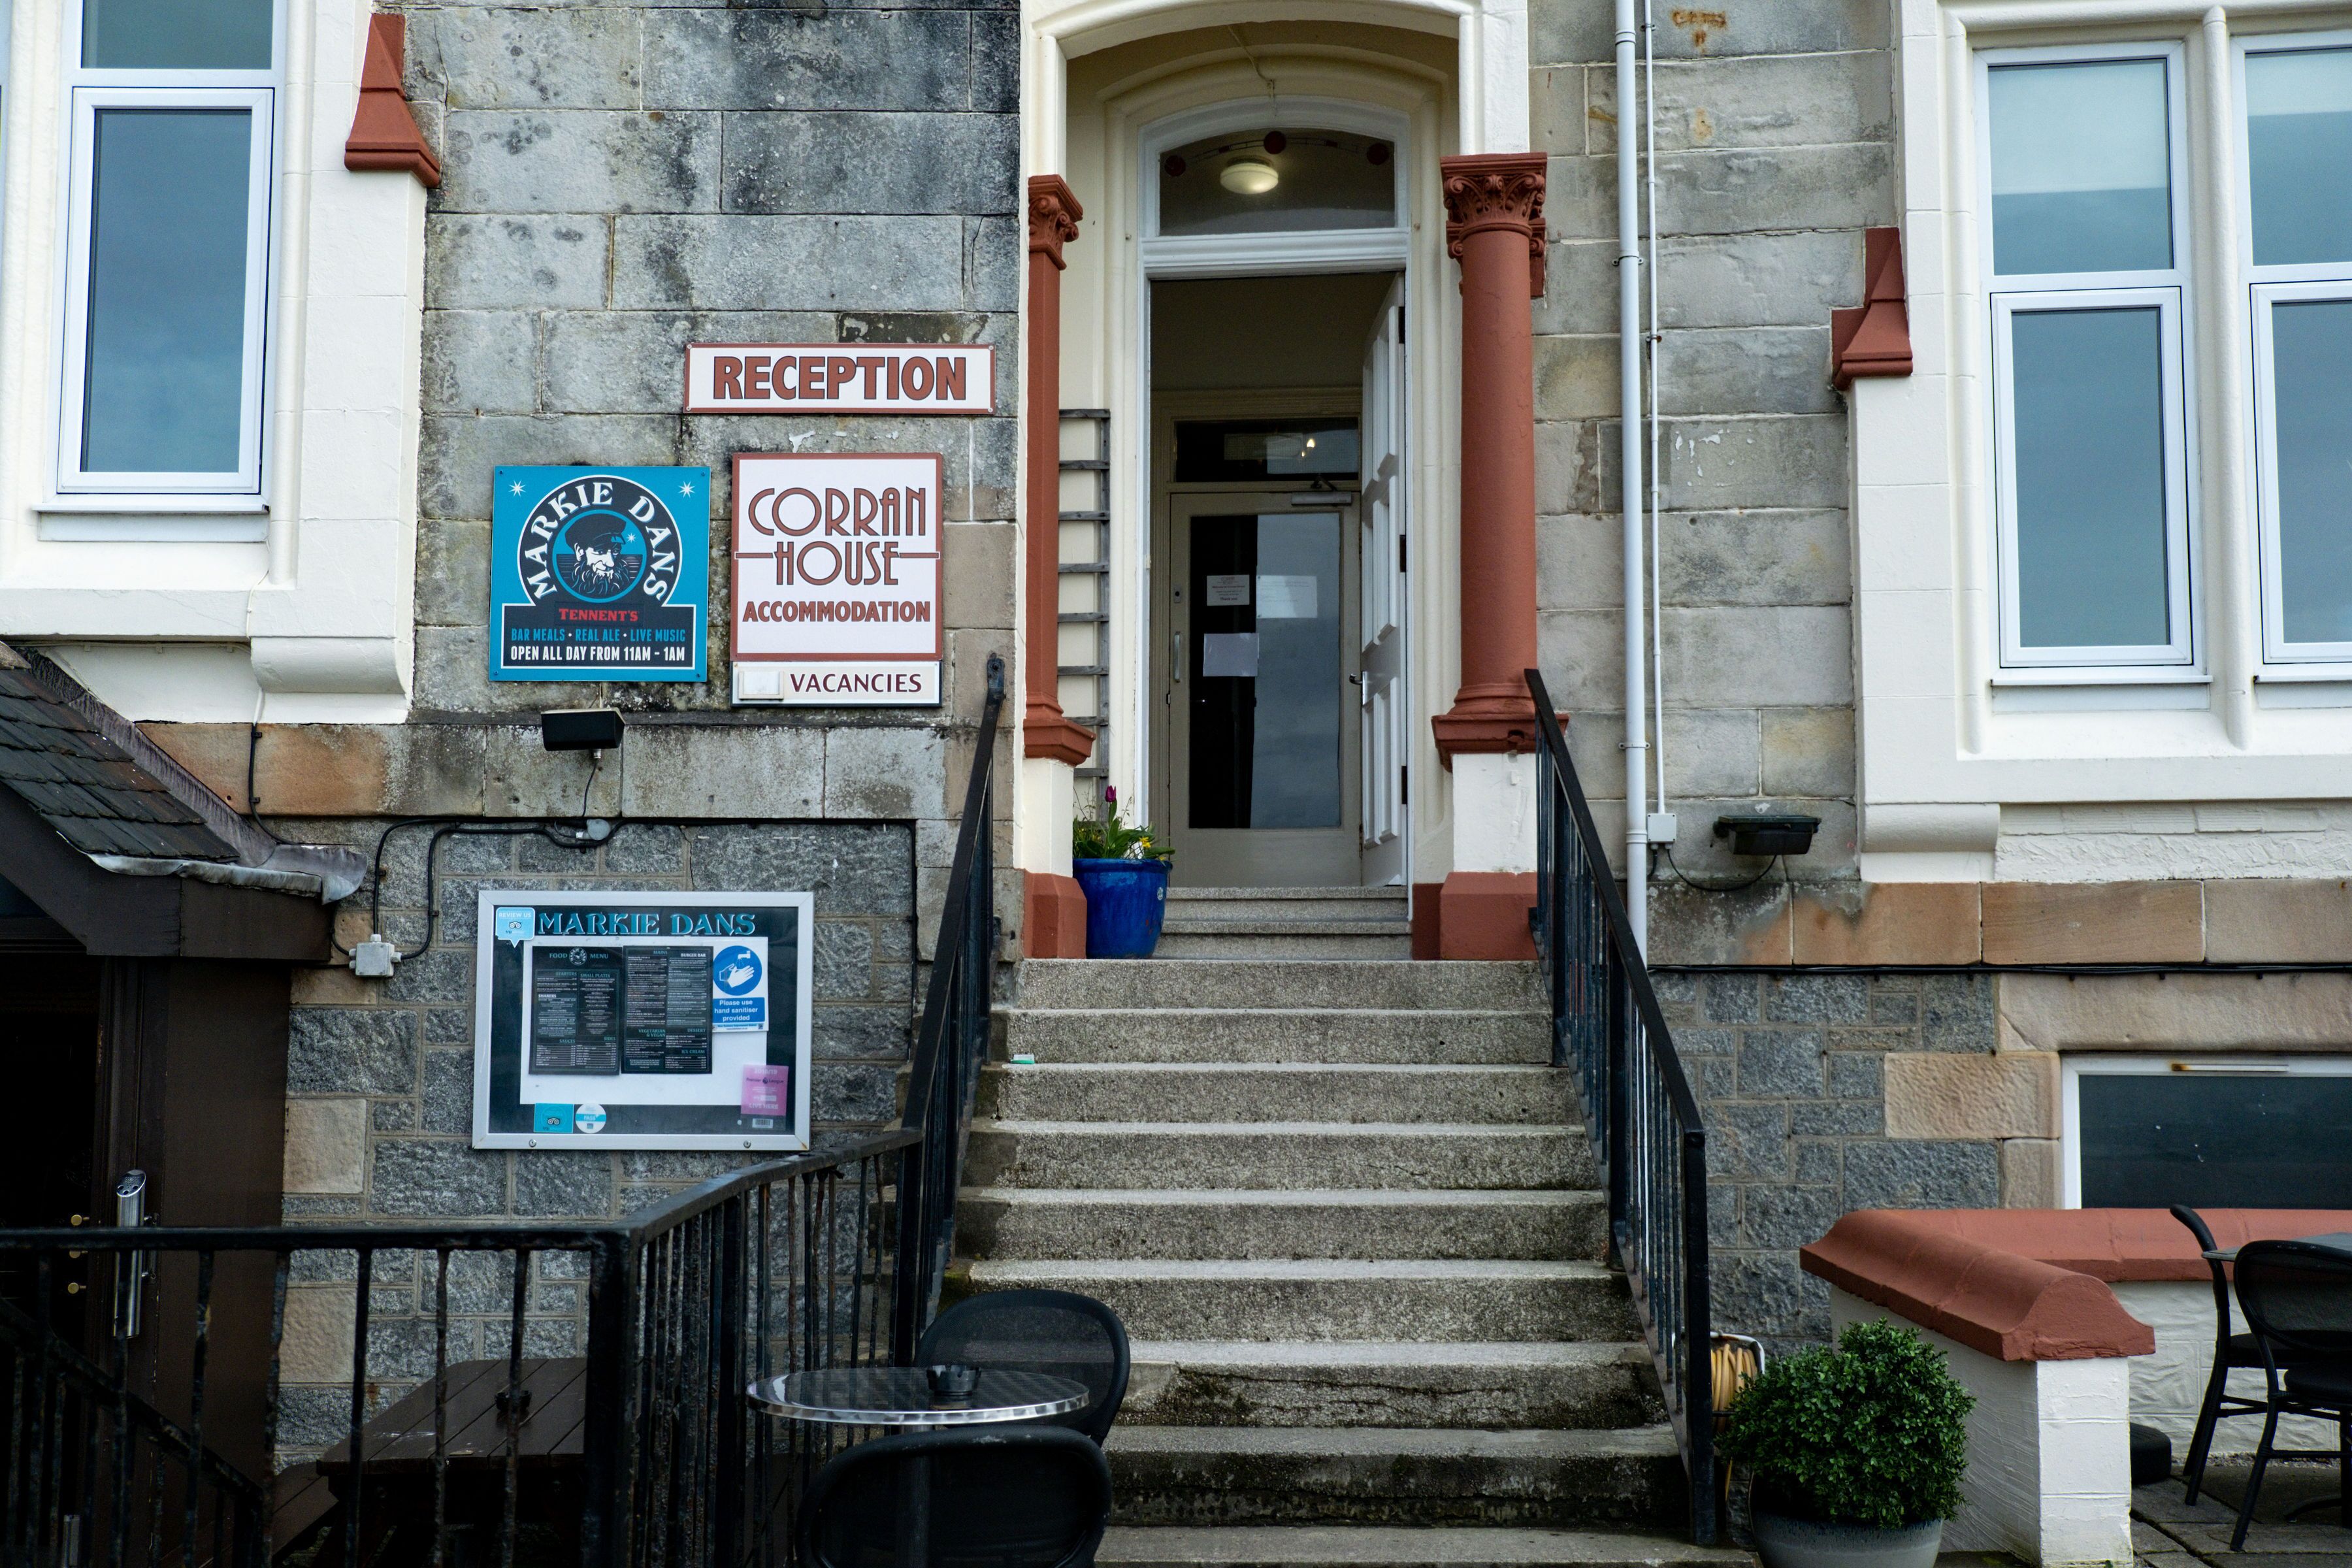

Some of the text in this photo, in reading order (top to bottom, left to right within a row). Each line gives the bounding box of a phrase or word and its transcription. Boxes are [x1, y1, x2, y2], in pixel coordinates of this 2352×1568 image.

[713, 356, 966, 400] RECEPTION
[748, 486, 926, 536] CORRAN
[525, 482, 676, 601] MARKIE DANS
[774, 541, 899, 585] HOUSE
[559, 608, 638, 621] TENNENT'S
[742, 600, 931, 623] ACCOMMODATION
[512, 629, 686, 642] BAR MEALS REAL ALE LIVE MUSIC
[510, 646, 539, 661] OPEN
[542, 646, 563, 661] ALL
[566, 646, 587, 661] DAY
[590, 647, 620, 661] FROM
[623, 647, 651, 661] 11AM
[663, 647, 685, 661] 1AM
[790, 674, 923, 693] VACANCIES
[538, 913, 755, 936] MARKIE DANS
